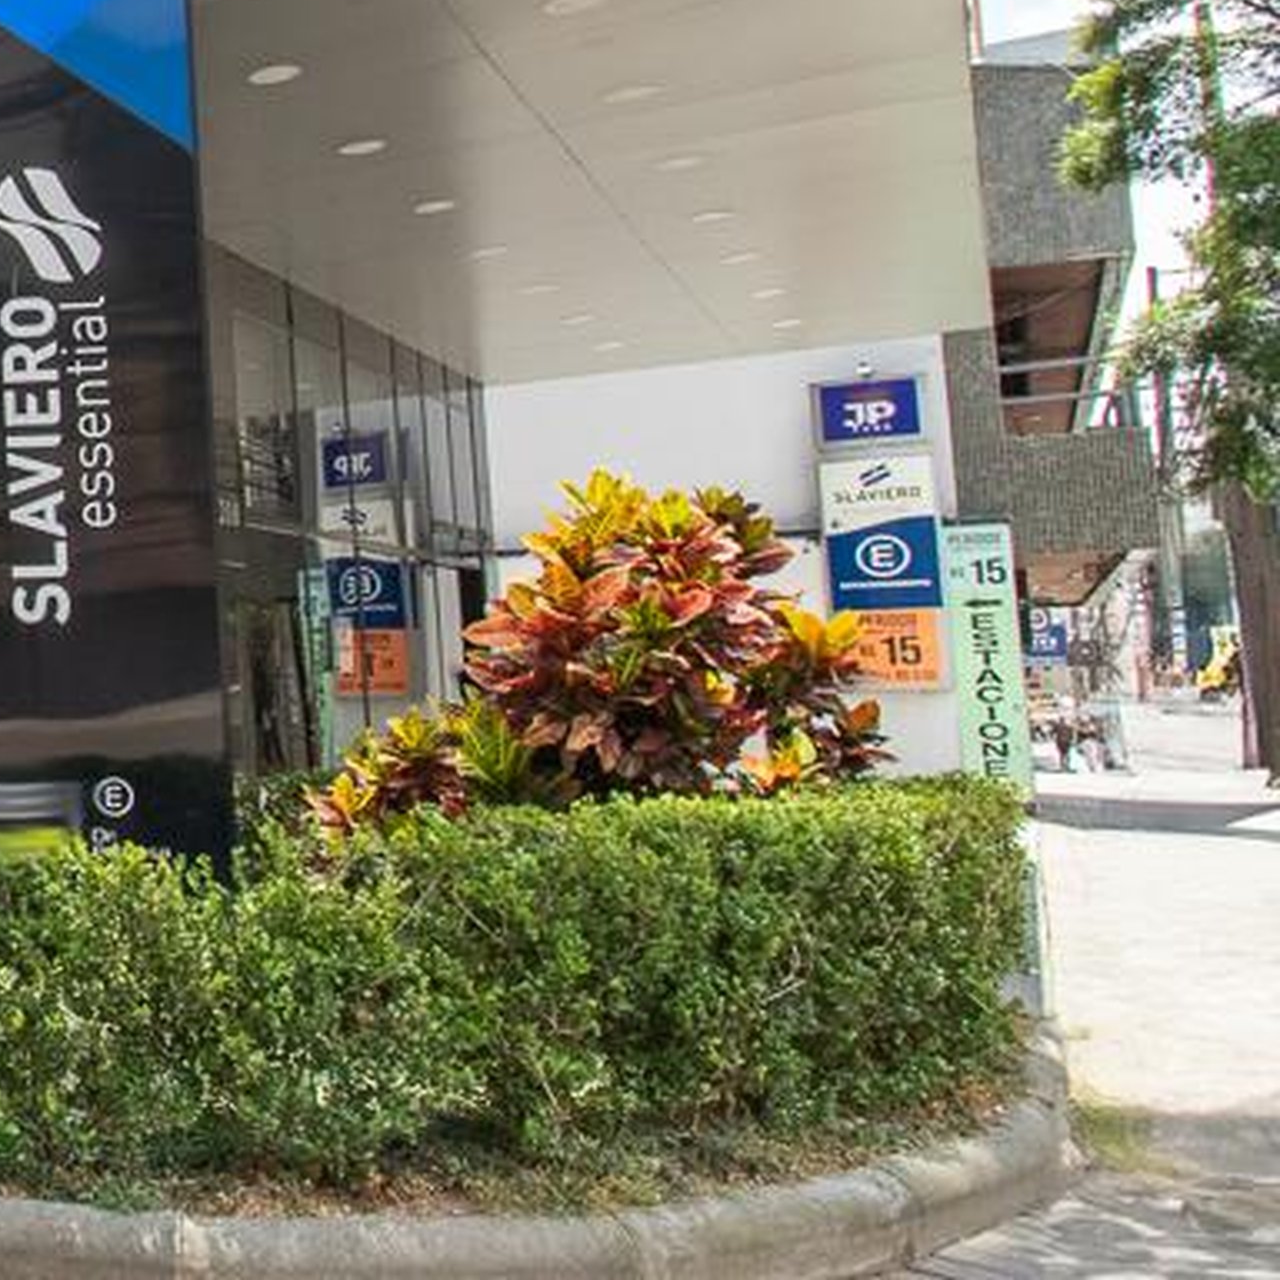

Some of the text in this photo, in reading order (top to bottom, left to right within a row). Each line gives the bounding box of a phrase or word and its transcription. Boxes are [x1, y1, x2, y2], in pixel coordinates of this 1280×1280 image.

[0, 296, 69, 626] SLAVIERO
[60, 296, 118, 529] essential
[972, 558, 1007, 584] 15
[881, 635, 922, 667] 15
